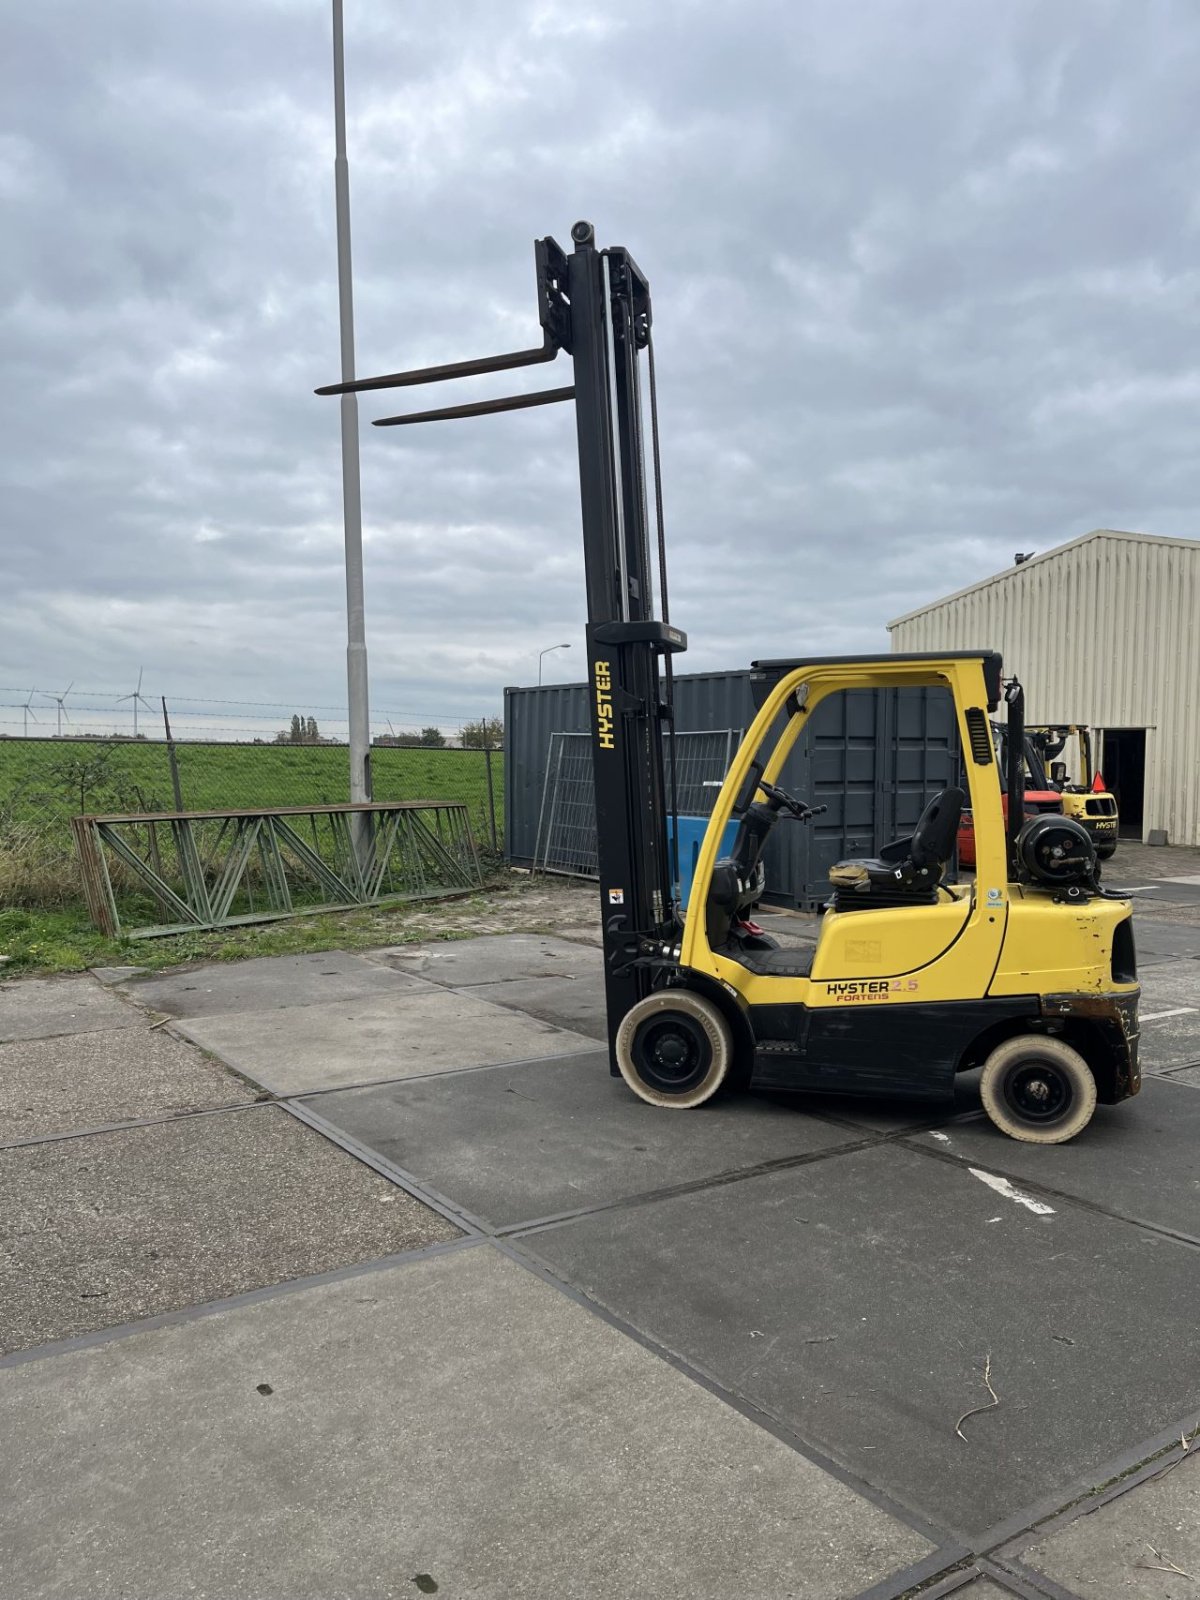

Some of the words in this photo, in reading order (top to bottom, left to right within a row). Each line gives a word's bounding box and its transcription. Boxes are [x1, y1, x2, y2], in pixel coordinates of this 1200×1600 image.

[594, 661, 615, 749] HYSTER
[827, 982, 889, 995] HYSTER
[891, 979, 918, 992] 2.5
[836, 993, 889, 1001] FORTENS
